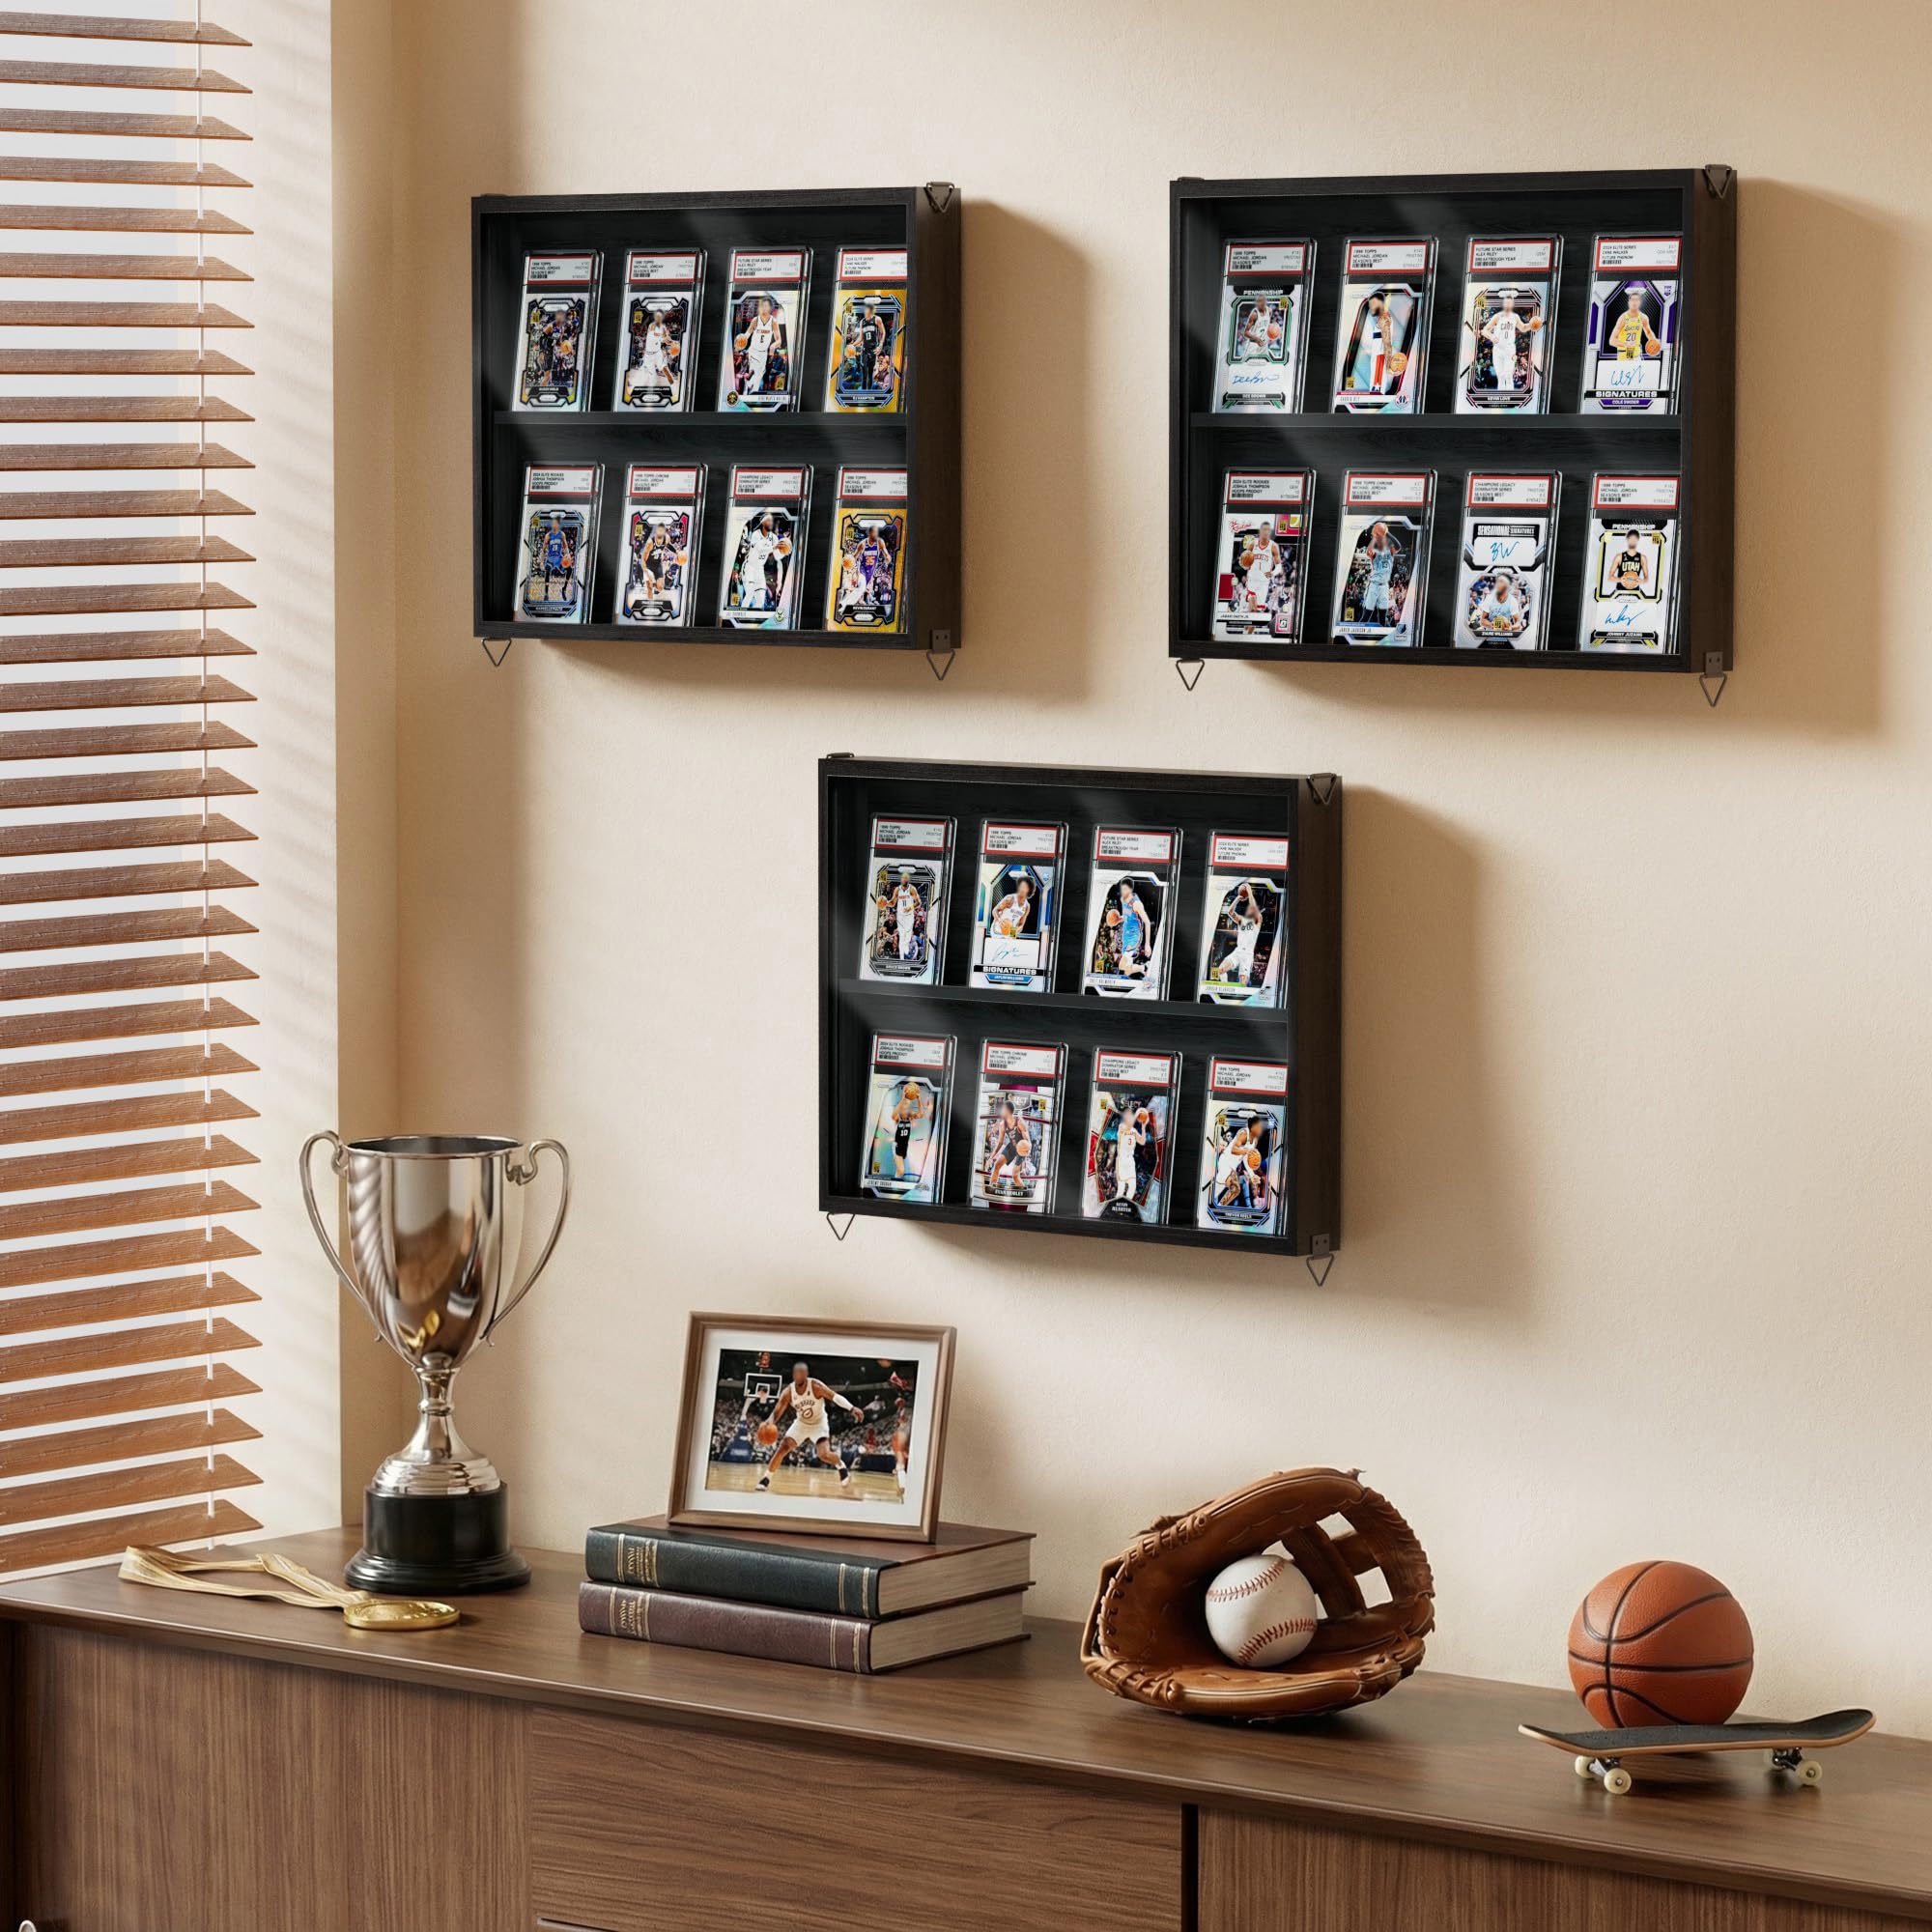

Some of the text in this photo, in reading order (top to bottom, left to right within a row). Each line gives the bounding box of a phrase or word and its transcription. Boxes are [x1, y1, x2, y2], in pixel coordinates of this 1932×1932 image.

[1627, 333, 1636, 342] 20
[1595, 390, 1658, 399] SIGNATURES
[865, 555, 875, 566] 35
[1622, 561, 1640, 572] UTAH
[982, 965, 1037, 976] SIGNATURES
